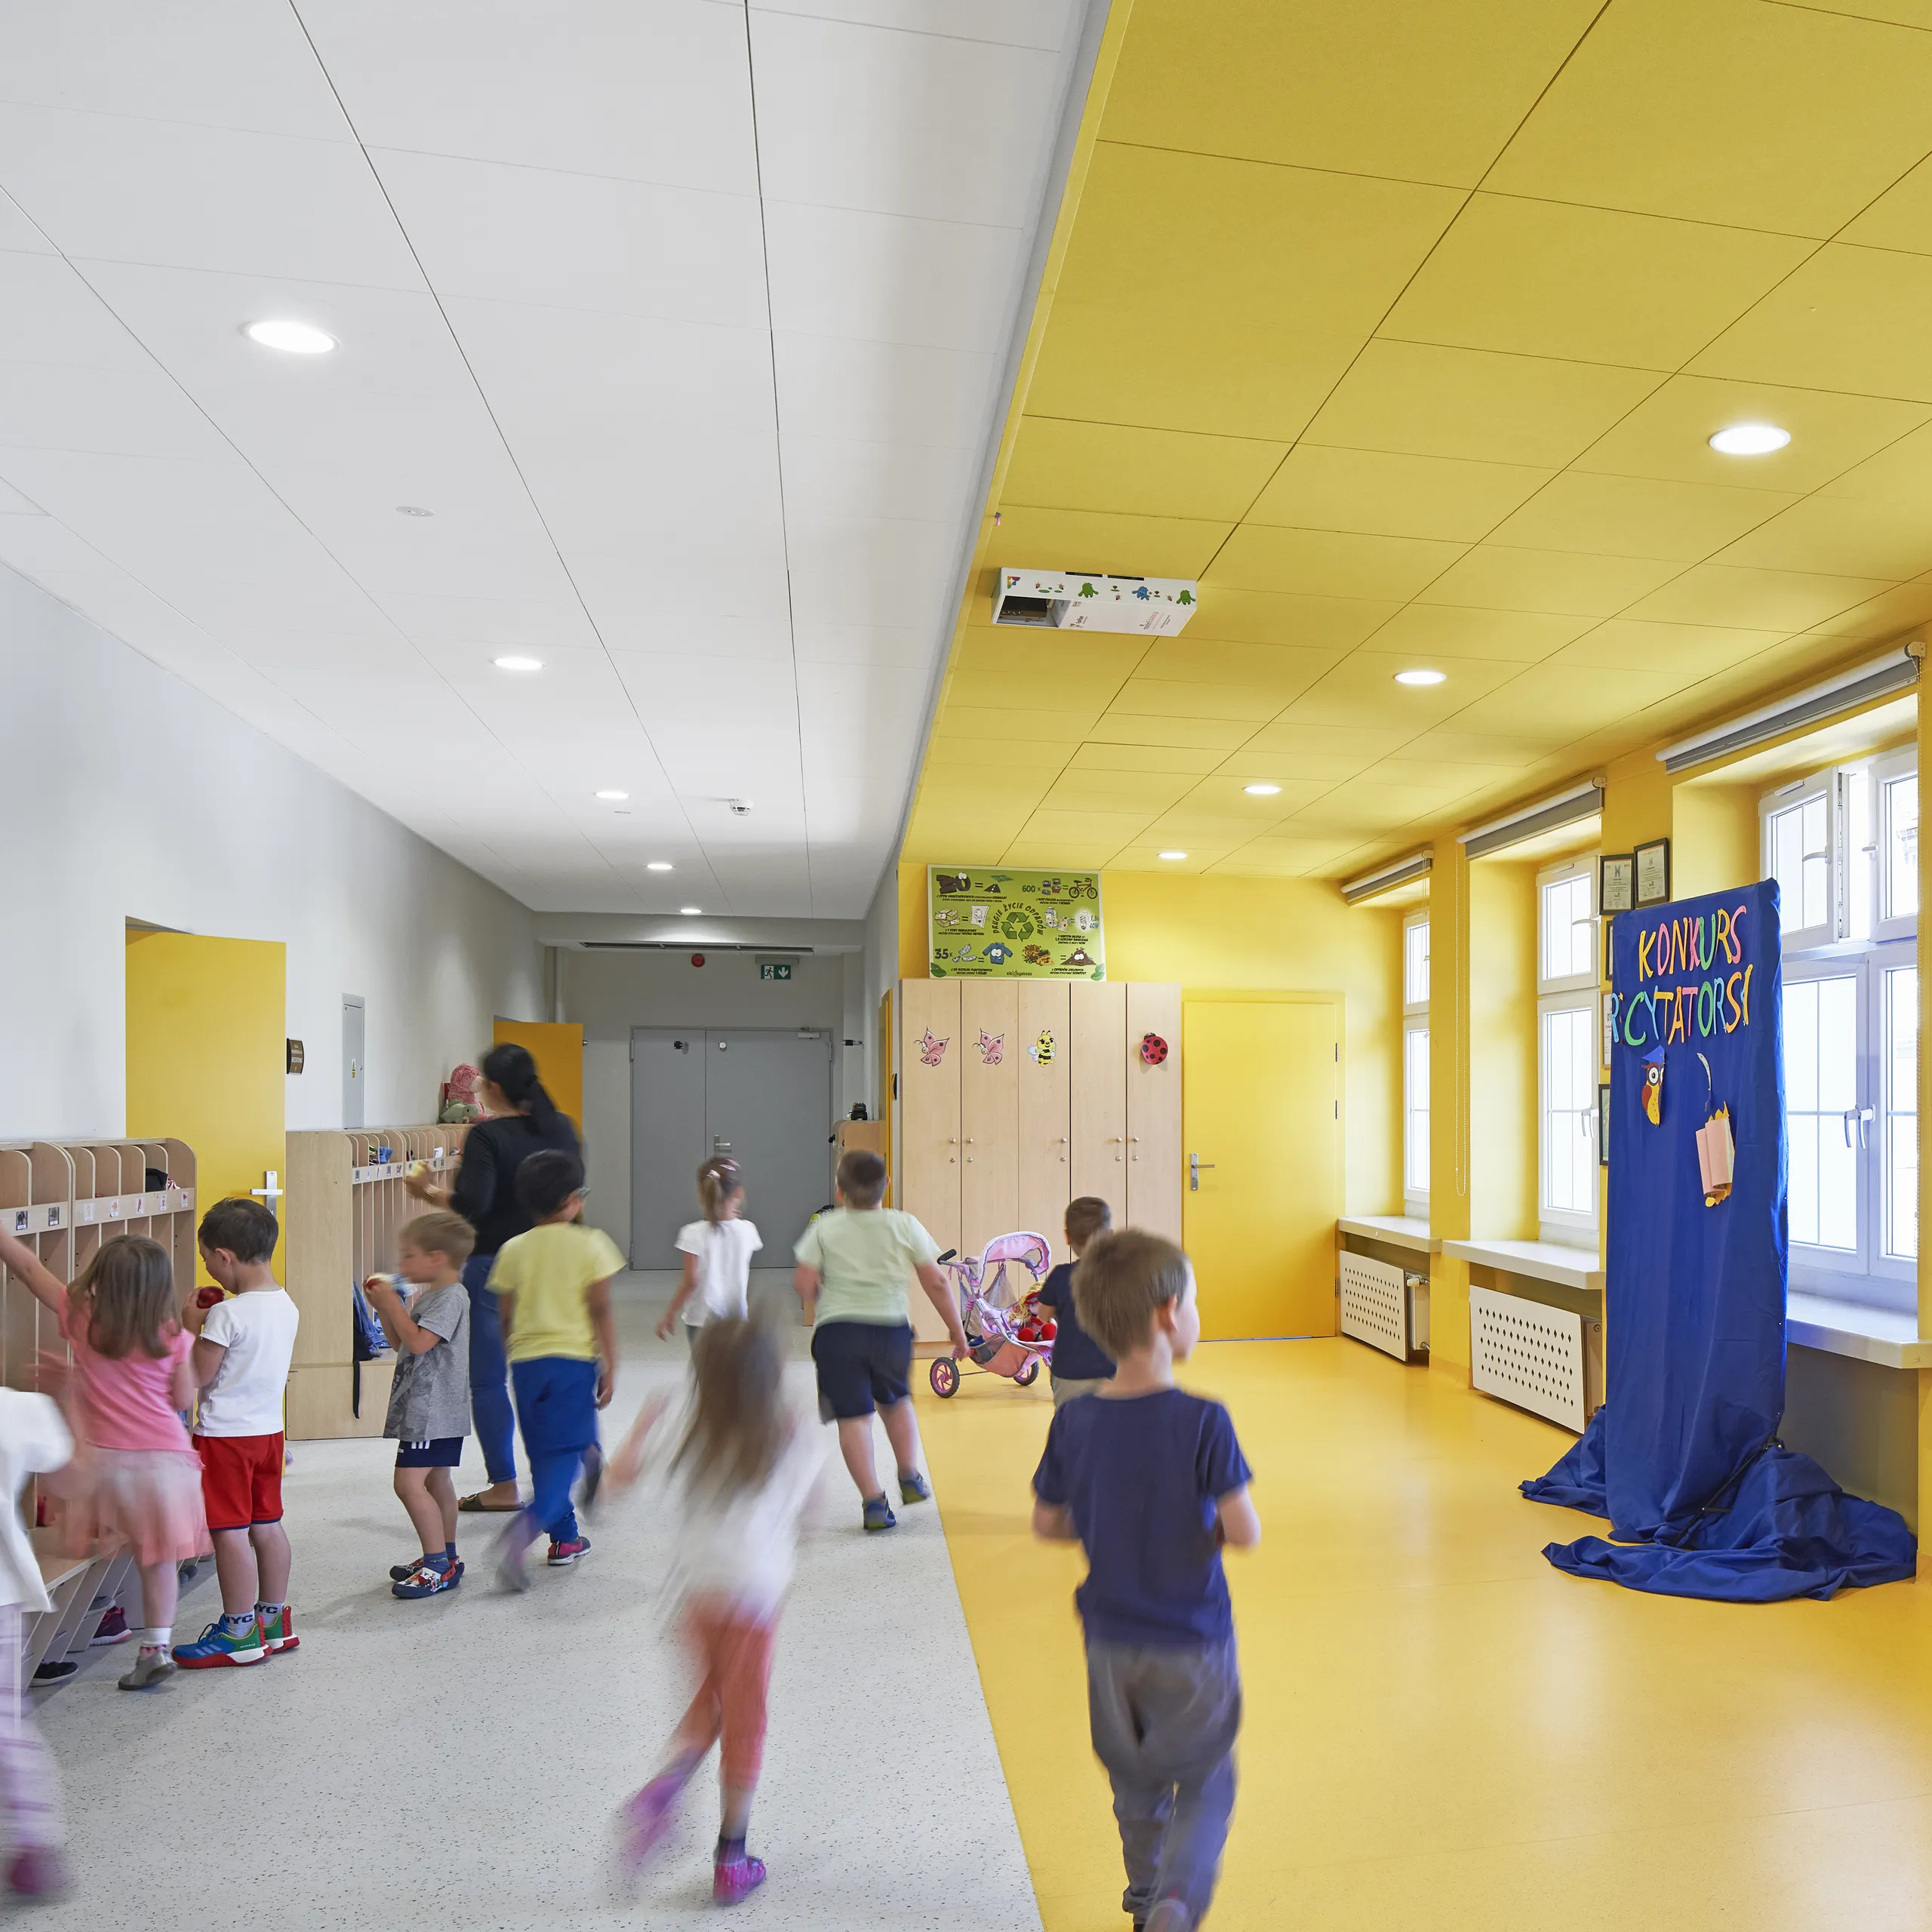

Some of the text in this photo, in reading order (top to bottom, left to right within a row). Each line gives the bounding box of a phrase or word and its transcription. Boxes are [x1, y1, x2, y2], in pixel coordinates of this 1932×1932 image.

[992, 903, 1047, 935] DRUGIE ŻYCIE ODPADÓW
[1638, 906, 1746, 982] KONKURS
